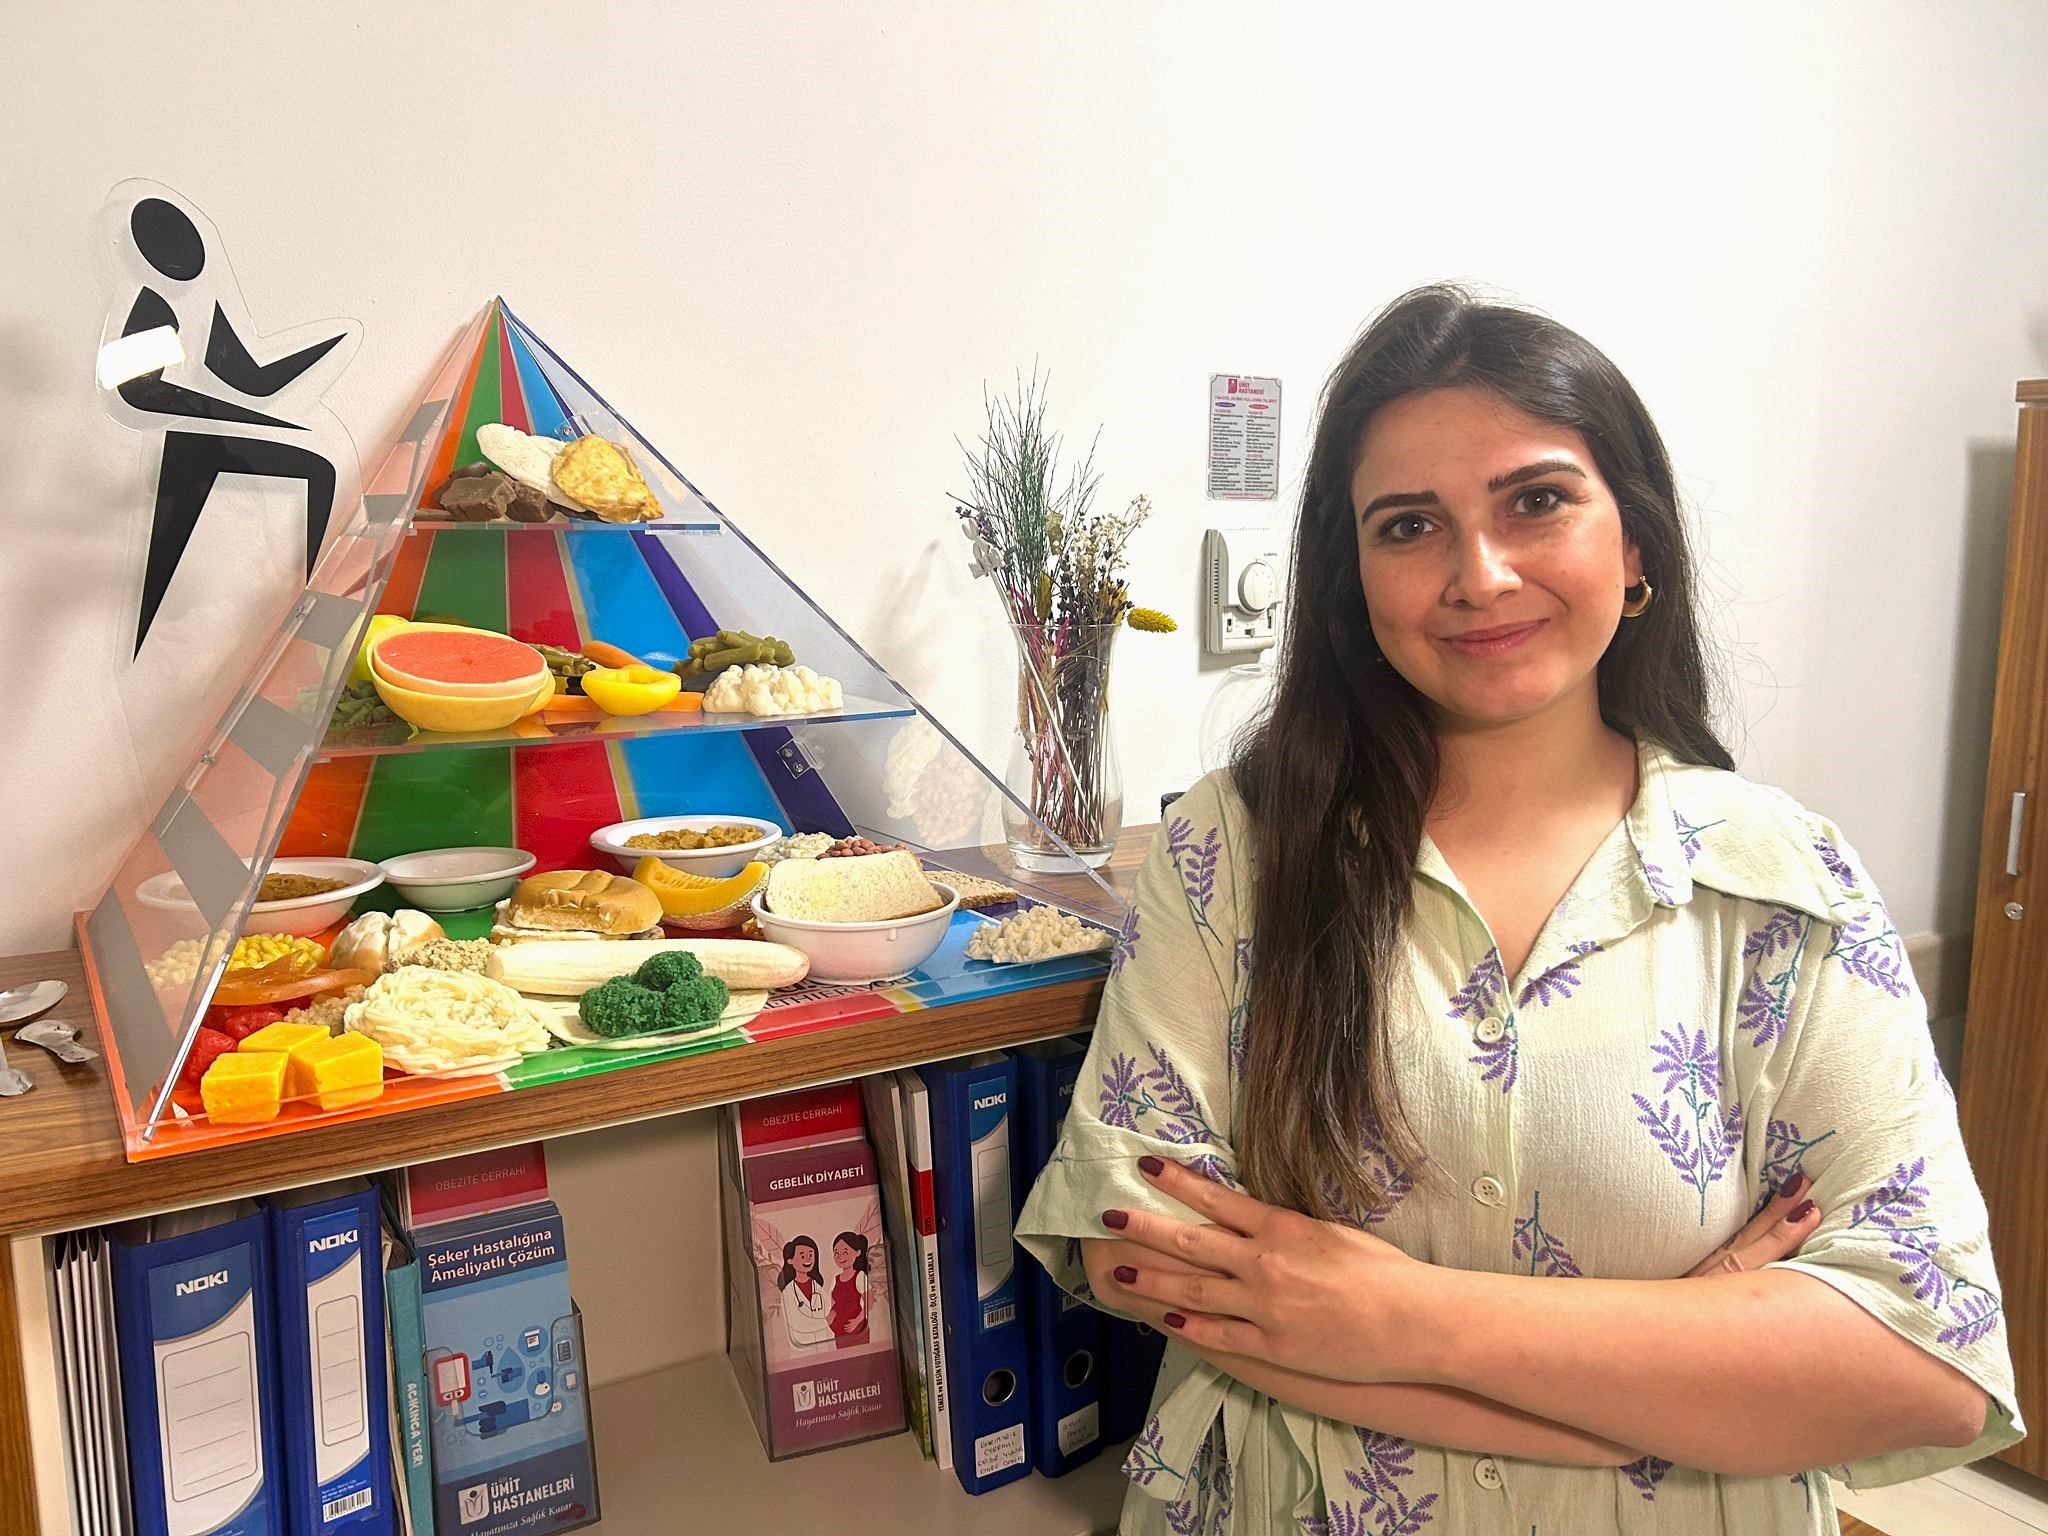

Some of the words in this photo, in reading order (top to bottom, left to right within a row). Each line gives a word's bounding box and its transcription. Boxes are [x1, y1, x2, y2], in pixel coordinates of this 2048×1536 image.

[974, 1092, 1006, 1110] NOKI
[1059, 1083, 1075, 1096] NO
[769, 1173, 814, 1191] GEBELİK
[816, 1164, 864, 1183] DİYABETİ
[309, 1229, 358, 1253] NOKI
[428, 1248, 470, 1269] Şeker
[473, 1230, 552, 1257] Hastalığına
[431, 1257, 505, 1283] Ameliyatlı
[508, 1245, 555, 1268] Çözüm
[175, 1269, 229, 1297] NOKI
[816, 1378, 839, 1394] ÜMİT
[818, 1381, 881, 1408] HASTANELERİ
[838, 1406, 860, 1420] Sağlık
[491, 1477, 520, 1498] ÜMİT
[493, 1473, 575, 1515] HASTANELERİ
[521, 1510, 546, 1526] Sağlık
